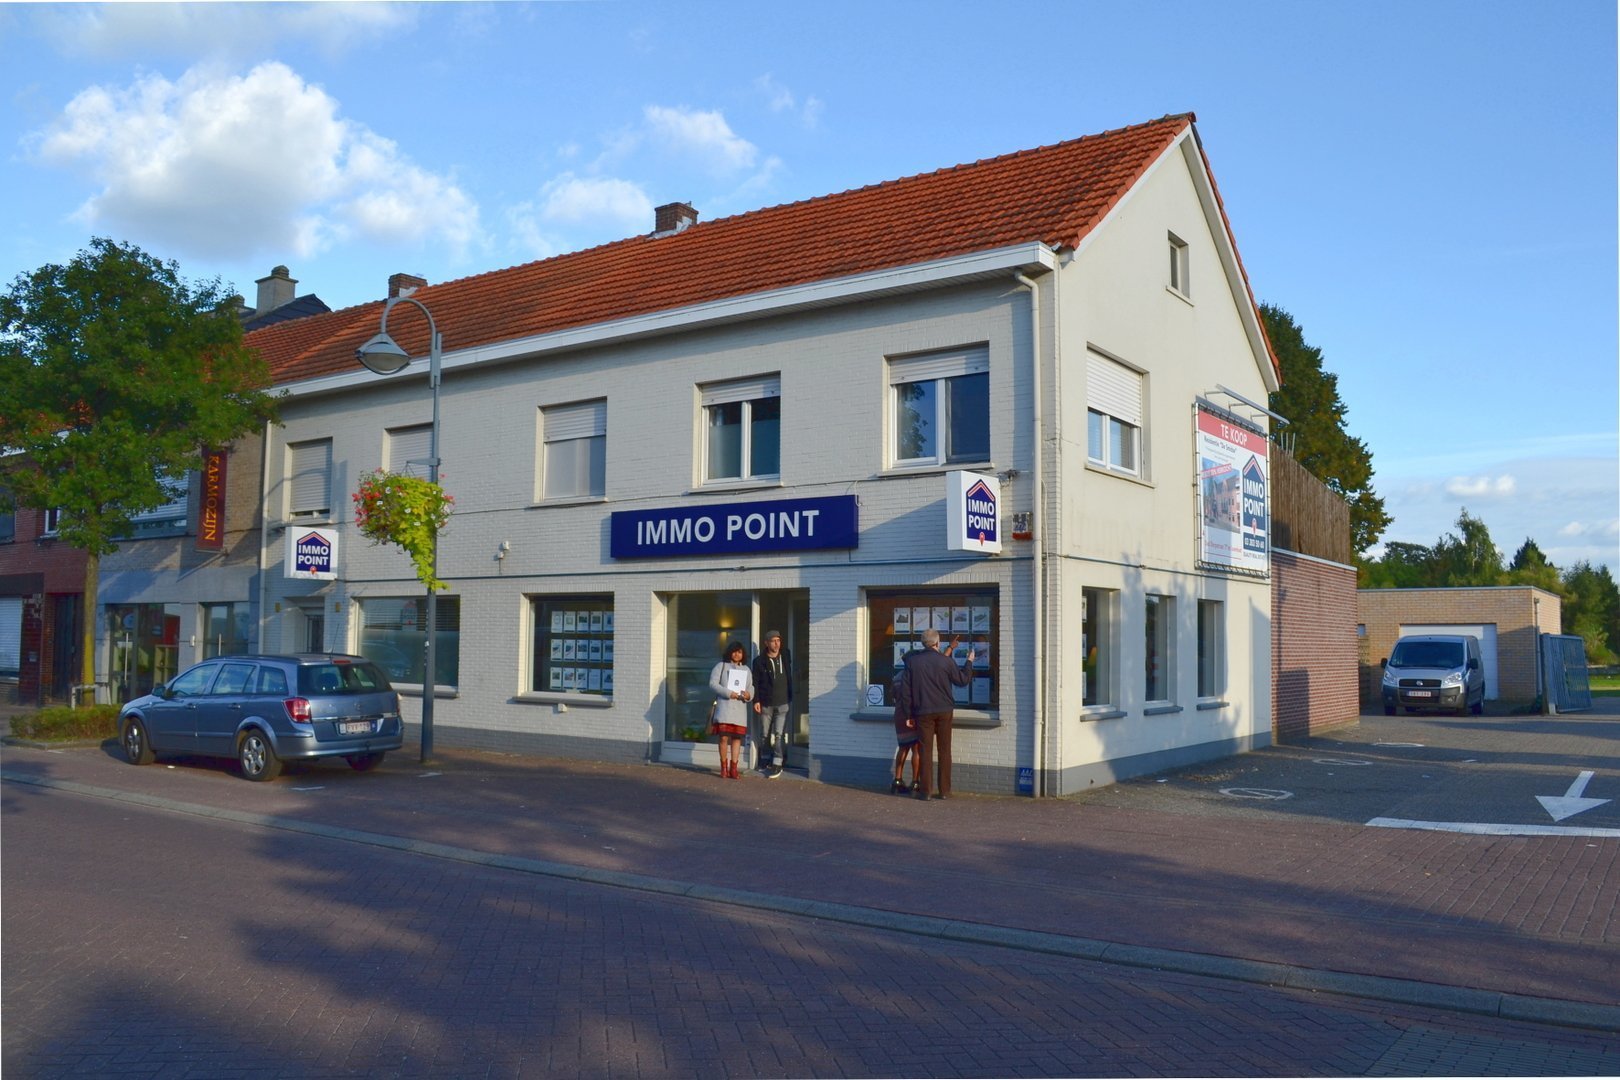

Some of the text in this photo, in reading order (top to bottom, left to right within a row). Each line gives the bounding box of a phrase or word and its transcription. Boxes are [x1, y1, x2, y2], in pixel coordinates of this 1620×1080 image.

[1220, 424, 1229, 439] TE
[1230, 428, 1248, 446] KOOP
[202, 455, 221, 541] KARMOZIJN
[1243, 478, 1264, 499] IMMO
[968, 499, 995, 516] IMMO
[1244, 498, 1265, 517] POINT
[637, 510, 820, 545] IMMO POINT
[968, 514, 995, 531] POINT
[298, 545, 329, 556] IMMO
[298, 555, 329, 566] POINT
